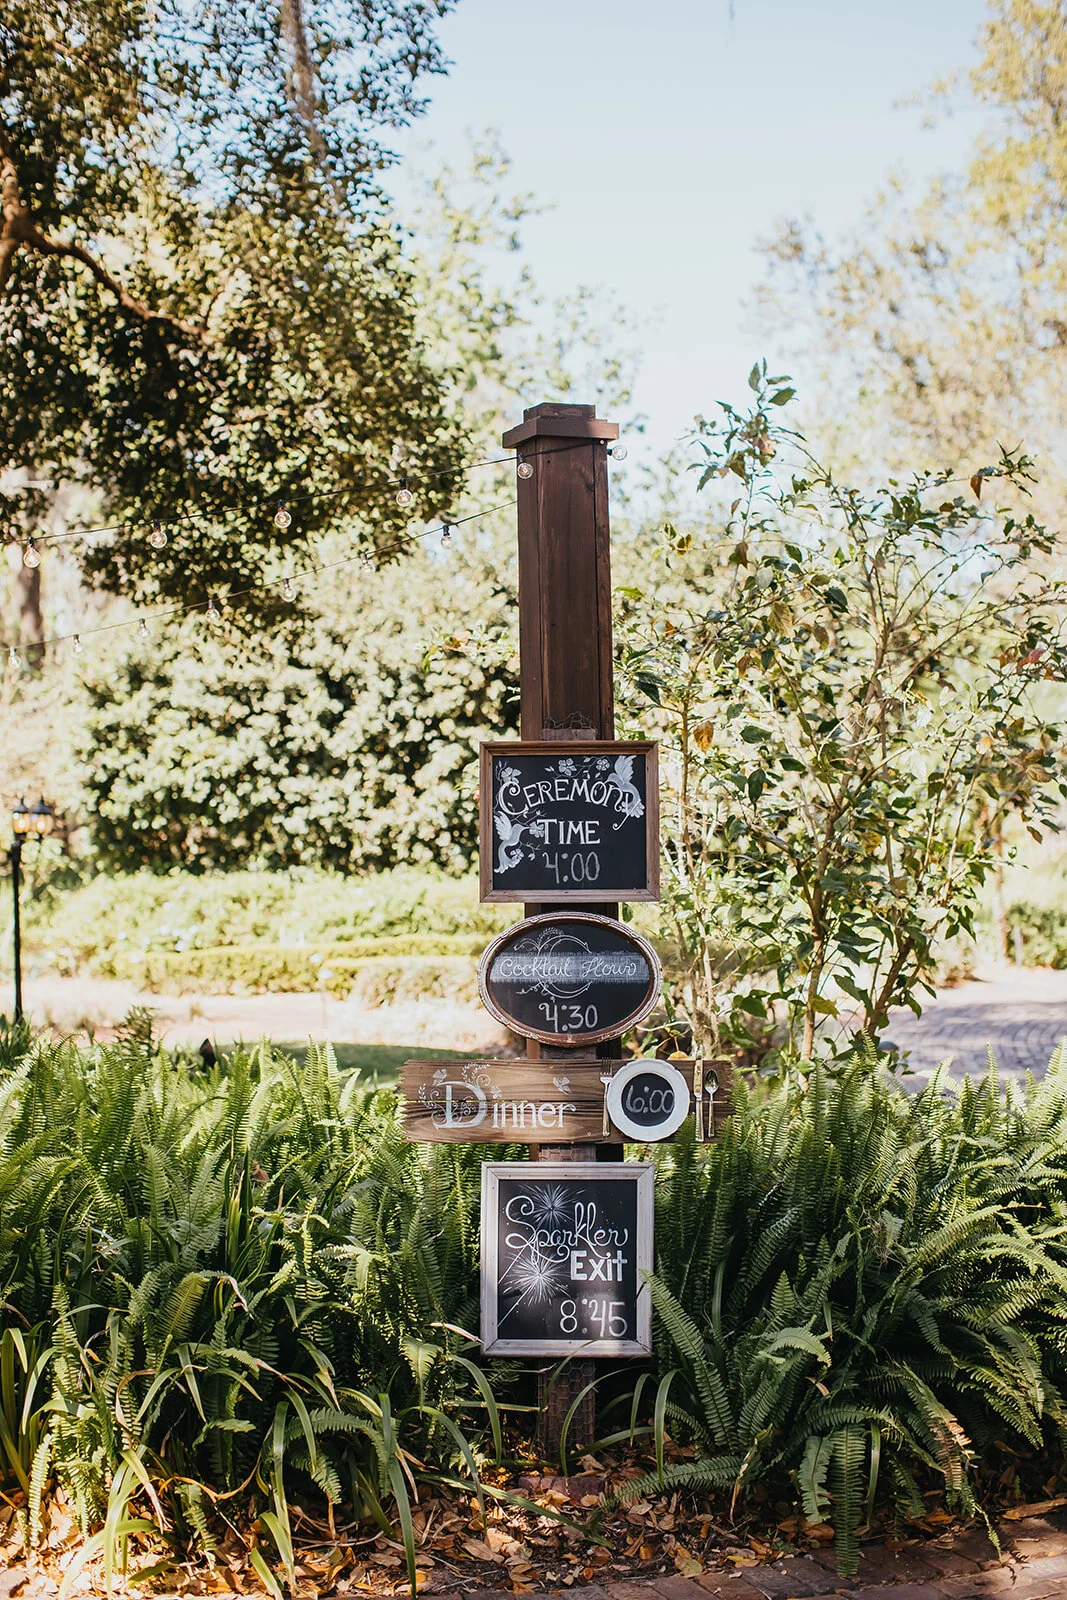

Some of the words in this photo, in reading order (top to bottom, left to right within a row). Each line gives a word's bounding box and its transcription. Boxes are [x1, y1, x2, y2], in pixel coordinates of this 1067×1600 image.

[537, 819, 600, 844] TIME
[542, 851, 600, 884] 4:00
[500, 957, 572, 978] Cocktail
[582, 957, 636, 977] Hour
[539, 1003, 598, 1033] 4:30
[432, 1080, 577, 1130] Dinner
[625, 1085, 675, 1114] 6:00
[505, 1195, 628, 1265] Sparkler
[570, 1250, 628, 1281] Exit
[560, 1299, 627, 1337] 8:45
